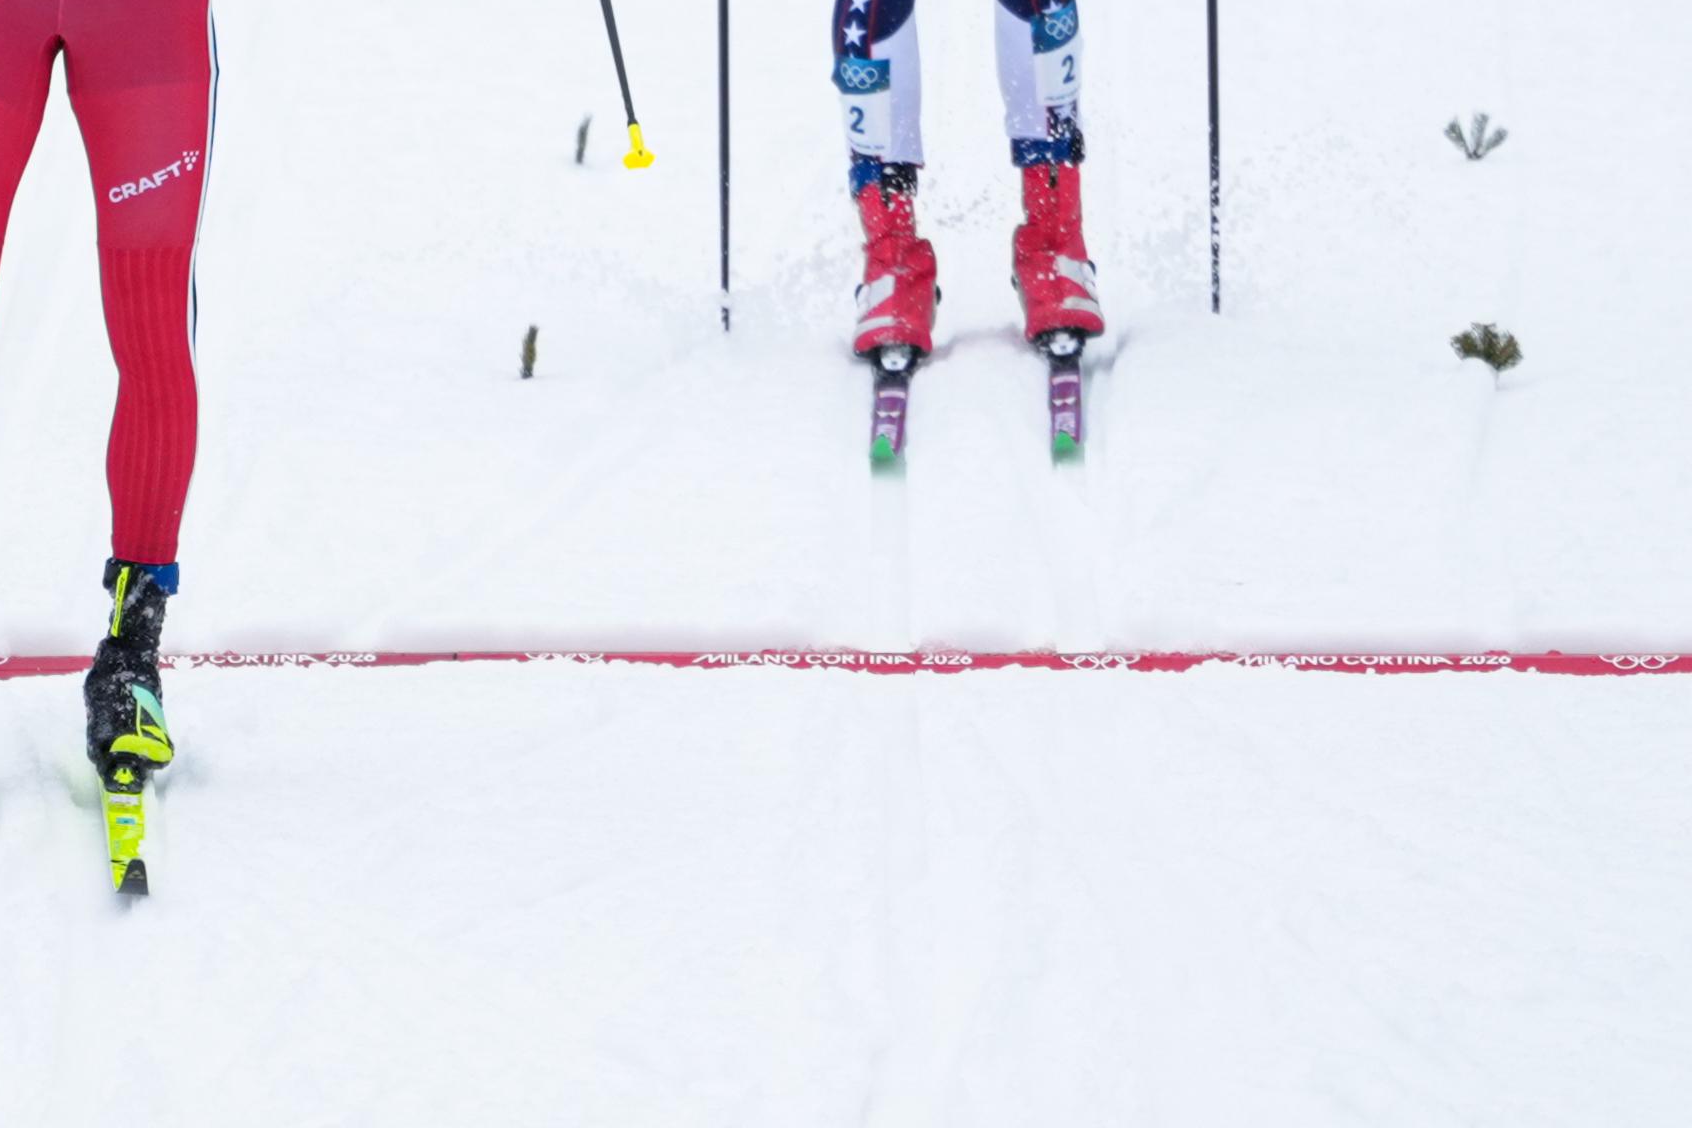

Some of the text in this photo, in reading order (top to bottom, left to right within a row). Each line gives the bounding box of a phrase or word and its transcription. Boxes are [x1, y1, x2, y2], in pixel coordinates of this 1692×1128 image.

[1061, 54, 1076, 84] 2
[849, 105, 865, 134] 2
[108, 160, 182, 203] CRAFT
[325, 653, 377, 663] 2026
[692, 653, 973, 665] MILANO CORTINA 2026
[1342, 655, 1454, 666] CORTINA
[1459, 655, 1512, 665] 2026
